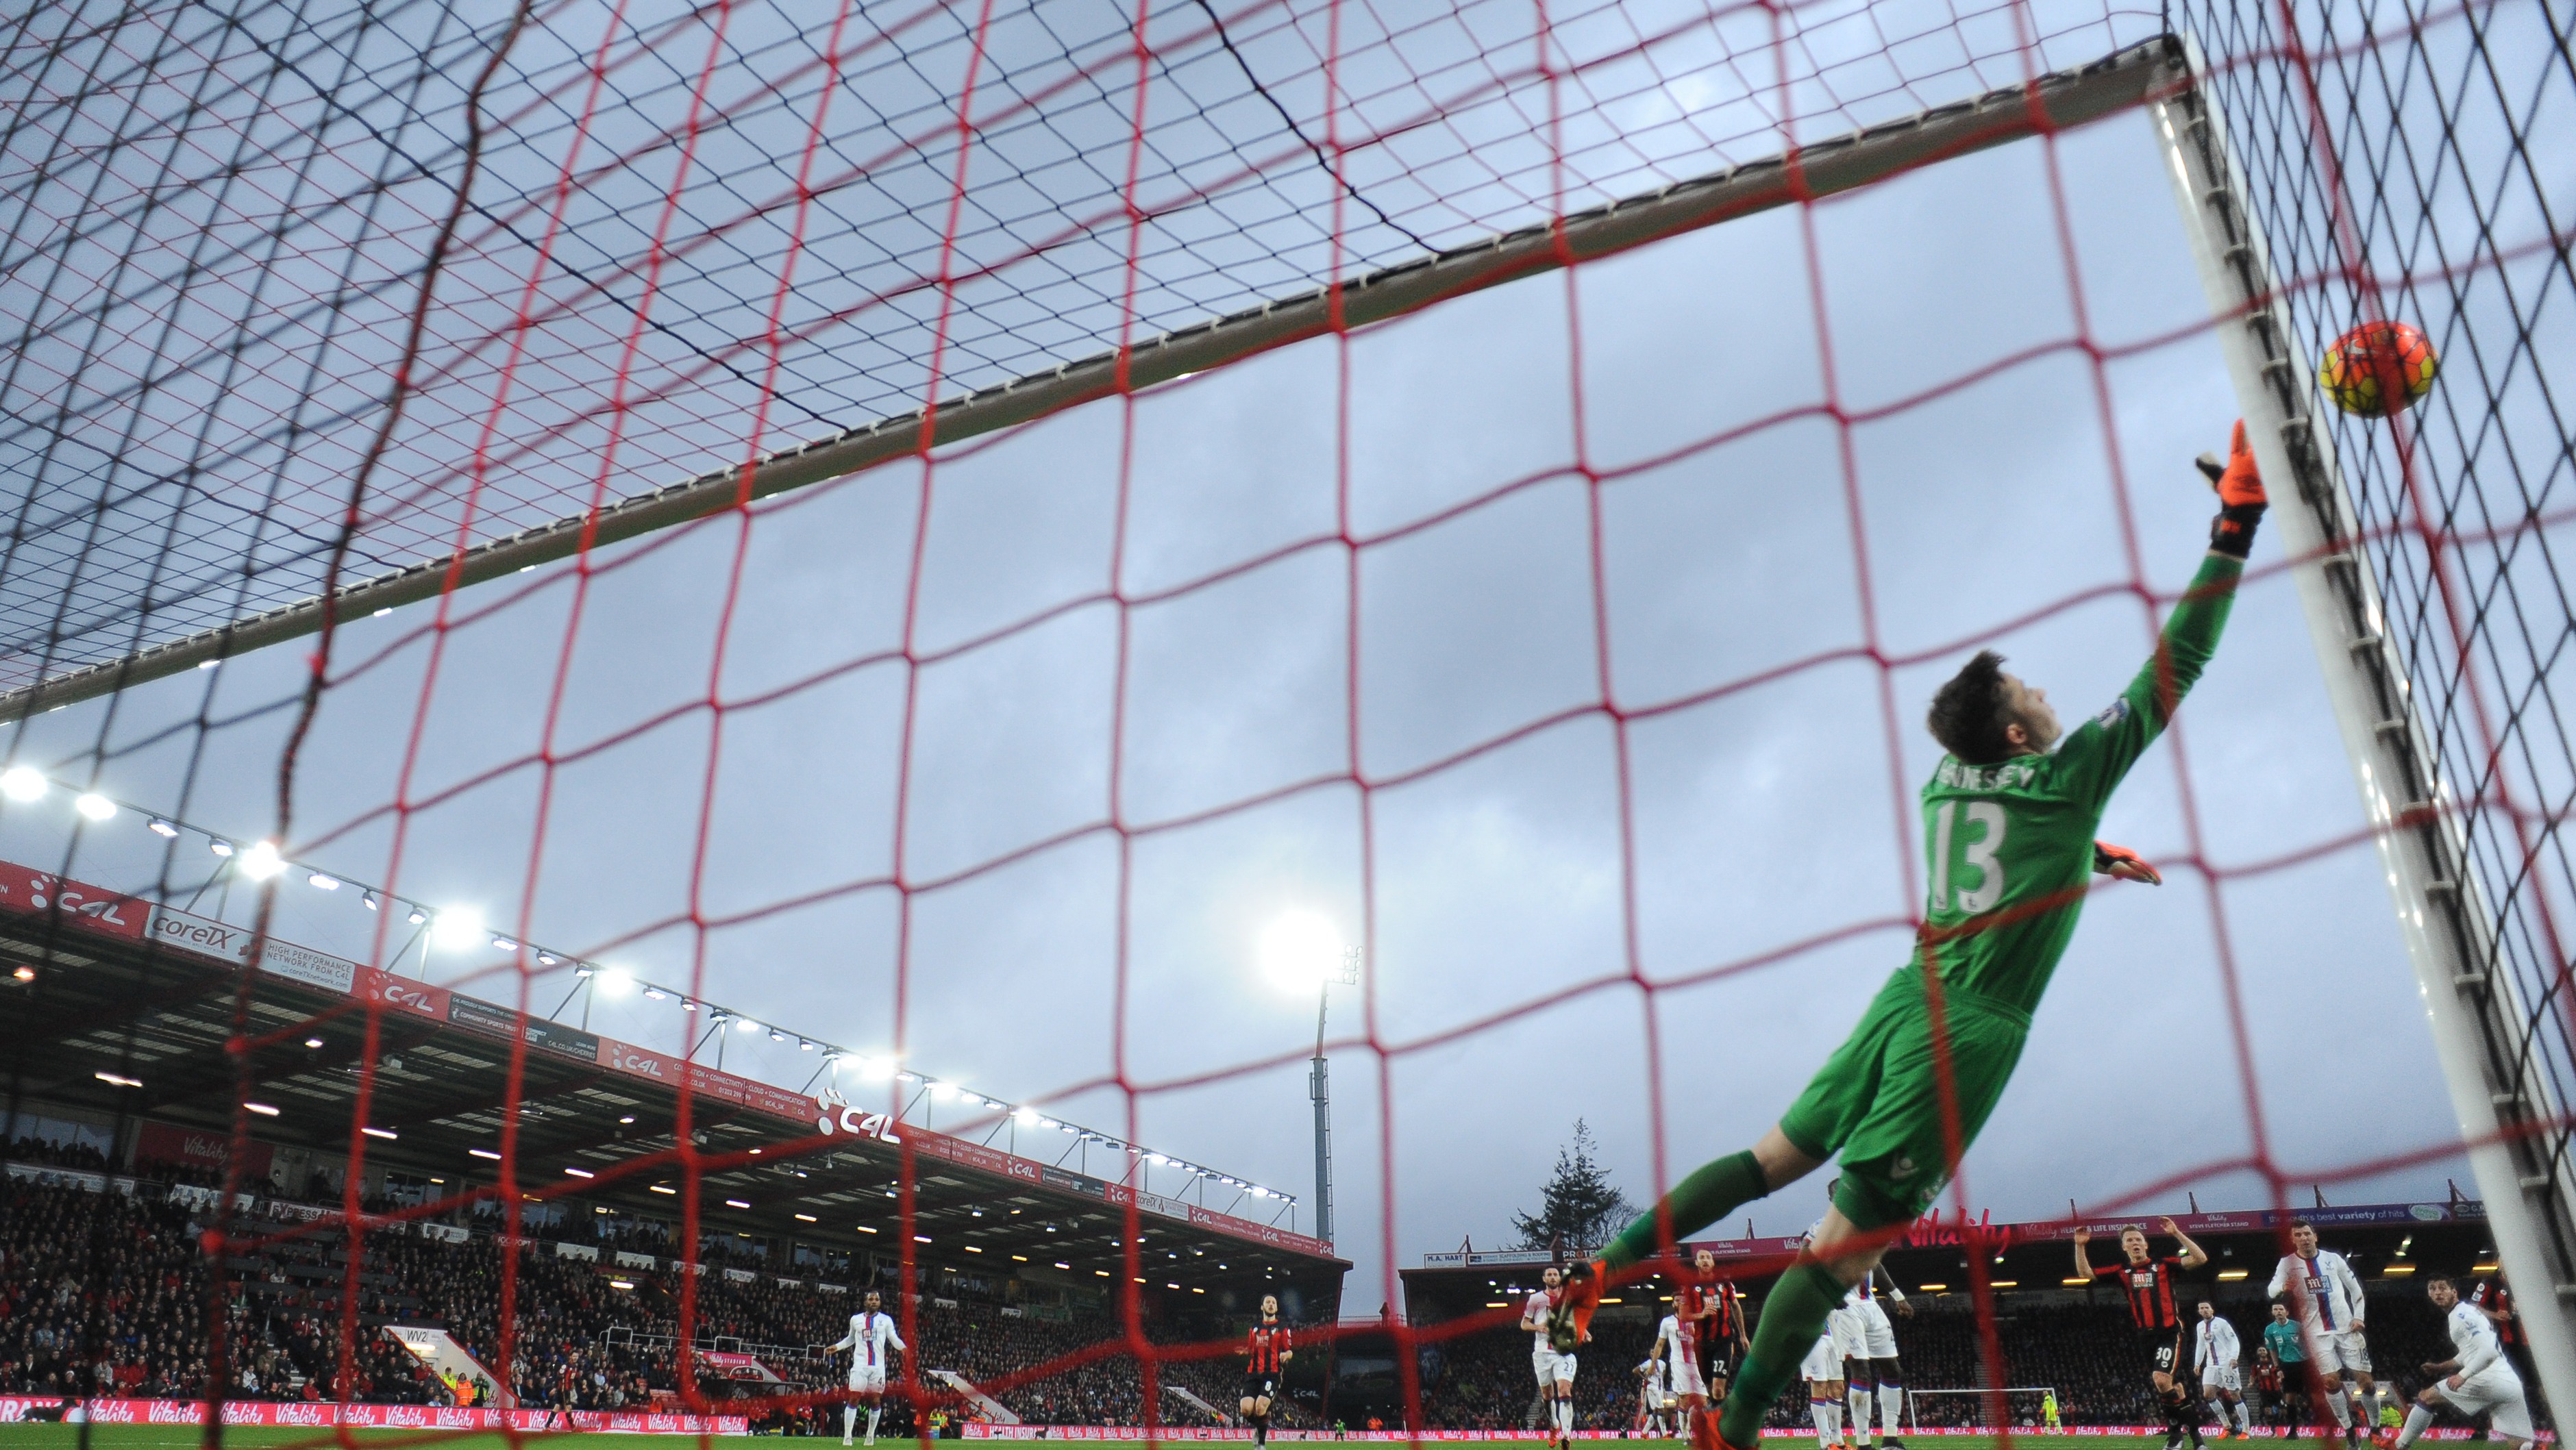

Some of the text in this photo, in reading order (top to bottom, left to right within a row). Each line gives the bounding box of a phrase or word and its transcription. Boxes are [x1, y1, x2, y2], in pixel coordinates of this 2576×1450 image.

[1934, 801, 2007, 912] 13
[58, 892, 125, 925] C4L
[152, 917, 237, 949] coreTX
[267, 951, 349, 980] NETWORK FROM C4L
[269, 943, 351, 973] HIGH PERFORMANCE
[289, 968, 348, 988] coreTXnetwork.com
[384, 986, 433, 1012] C4L
[460, 1012, 487, 1023] COMMUNITY
[626, 1055, 662, 1077] C4L
[710, 1074, 743, 1088] CONNECTIVITY
[749, 1085, 764, 1095] CLOUD
[769, 1090, 806, 1107] COMMUNICATIONS
[840, 1105, 901, 1145] C4L
[184, 1134, 228, 1164] Vitality
[1015, 1163, 1035, 1178] C4L
[1137, 1195, 1158, 1208] coreTX
[1197, 1212, 1212, 1224] C4L
[2338, 1211, 2375, 1221] variety
[1266, 1231, 1279, 1242] C4L
[1907, 1208, 2011, 1257] Vitality
[1323, 1245, 1333, 1255] C4L
[407, 1330, 428, 1342] WV2
[2156, 1347, 2172, 1361] 30
[1265, 1381, 1272, 1391] 8
[149, 1400, 201, 1423] Vitality
[275, 1403, 321, 1426] Vitality
[386, 1405, 426, 1427] Vitality
[436, 1406, 474, 1428] Vitality
[610, 1412, 641, 1432] Vitality
[648, 1414, 677, 1432] Vitality
[718, 1415, 745, 1432] Vitality
